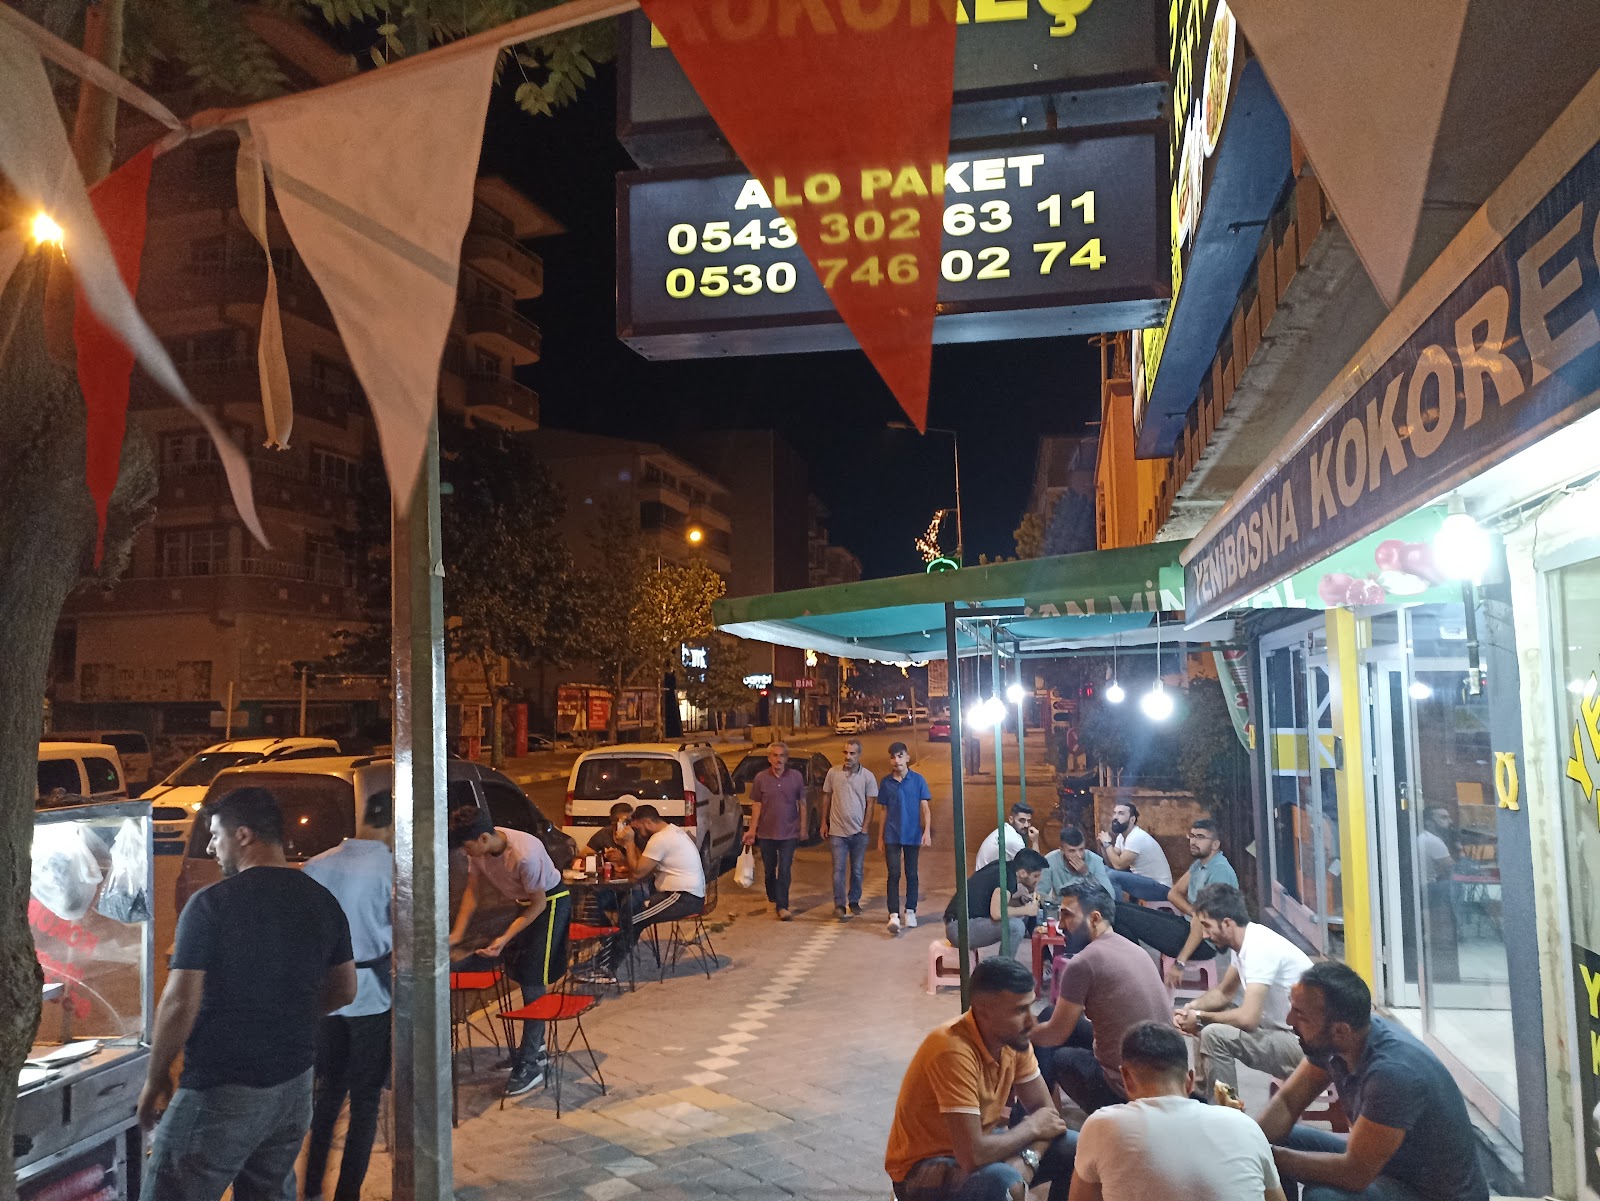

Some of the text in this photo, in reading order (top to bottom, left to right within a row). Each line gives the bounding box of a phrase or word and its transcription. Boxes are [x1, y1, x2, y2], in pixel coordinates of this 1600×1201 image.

[734, 154, 1045, 211] ALO PAKET
[667, 190, 1096, 255] 0543 302 63 11
[665, 238, 1107, 299] 0530 746 02 74
[1309, 200, 1600, 530] KOKORE
